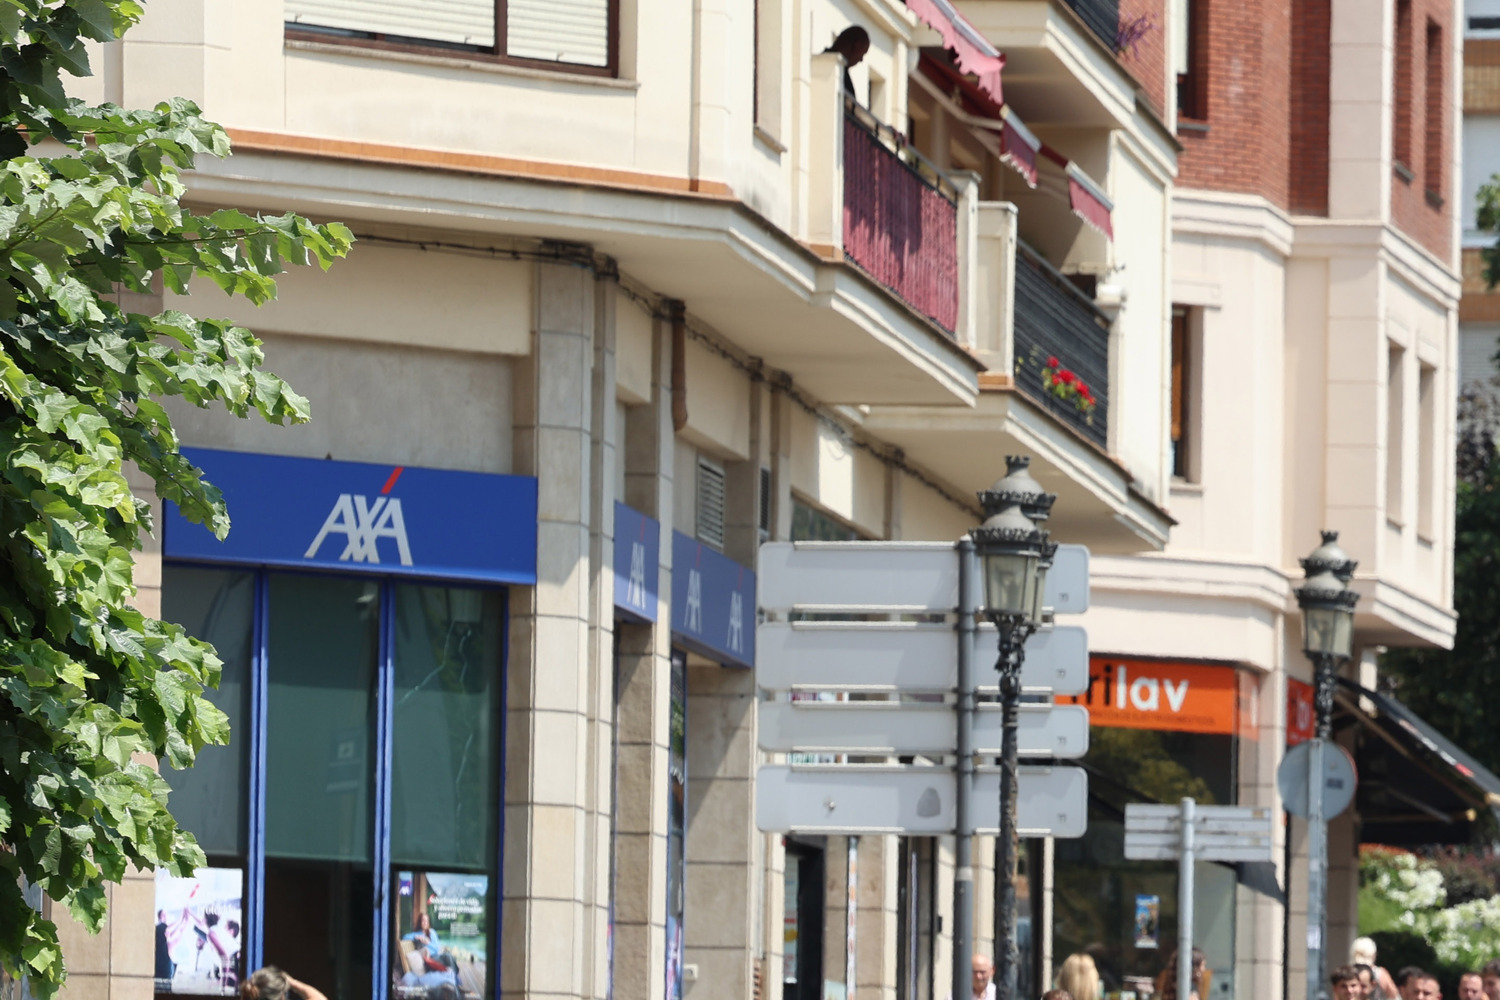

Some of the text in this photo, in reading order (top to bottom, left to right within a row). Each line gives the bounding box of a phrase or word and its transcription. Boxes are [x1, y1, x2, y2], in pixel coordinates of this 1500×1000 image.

[305, 492, 414, 567] AXA
[627, 541, 646, 611] AXA
[1070, 664, 1190, 713] rilav
